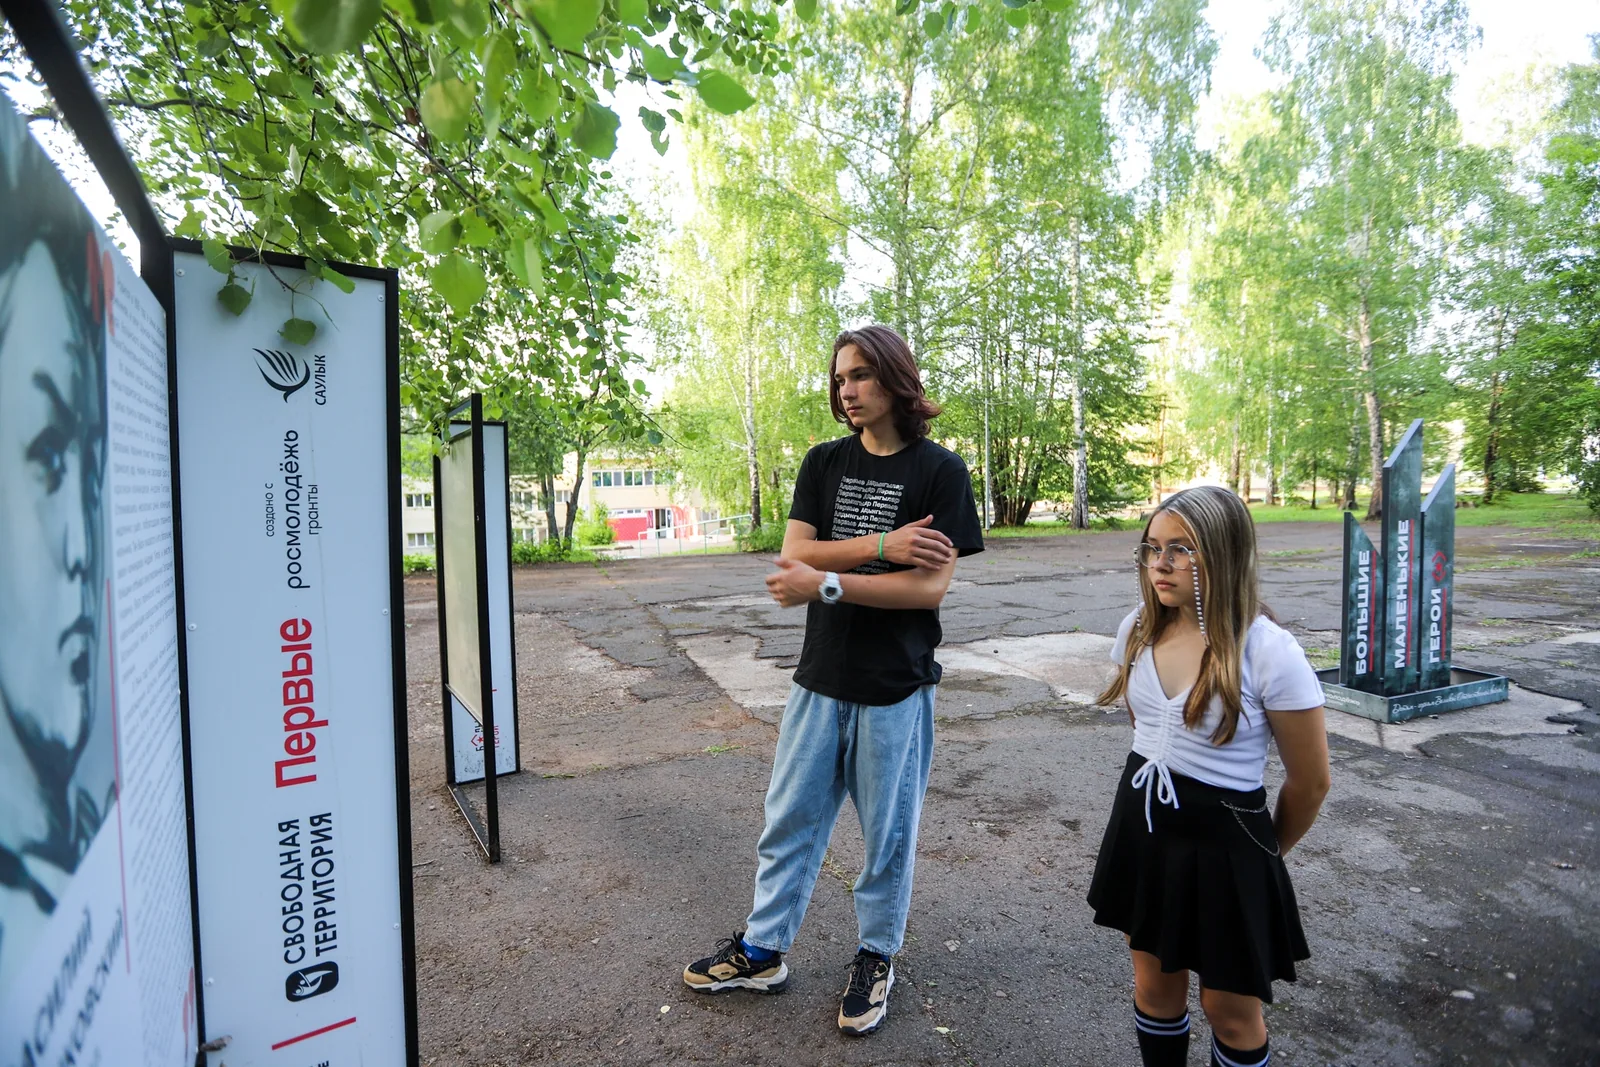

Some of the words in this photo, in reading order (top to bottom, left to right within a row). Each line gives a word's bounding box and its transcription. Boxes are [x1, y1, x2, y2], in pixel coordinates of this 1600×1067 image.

[314, 354, 326, 405] САУЛЫК
[265, 492, 276, 537] создано
[279, 429, 311, 589] росмолодёжь
[307, 484, 323, 535] гранты
[1355, 550, 1370, 675] БОЛЬШИЕ
[1394, 519, 1409, 669] МАЛЕНЬКИЕ
[1429, 588, 1442, 664] ГЕРОИ
[275, 618, 329, 788] Первые
[278, 819, 306, 964] СВОБОДНАЯ
[309, 812, 338, 957] ТЕРРИТОРИЯ
